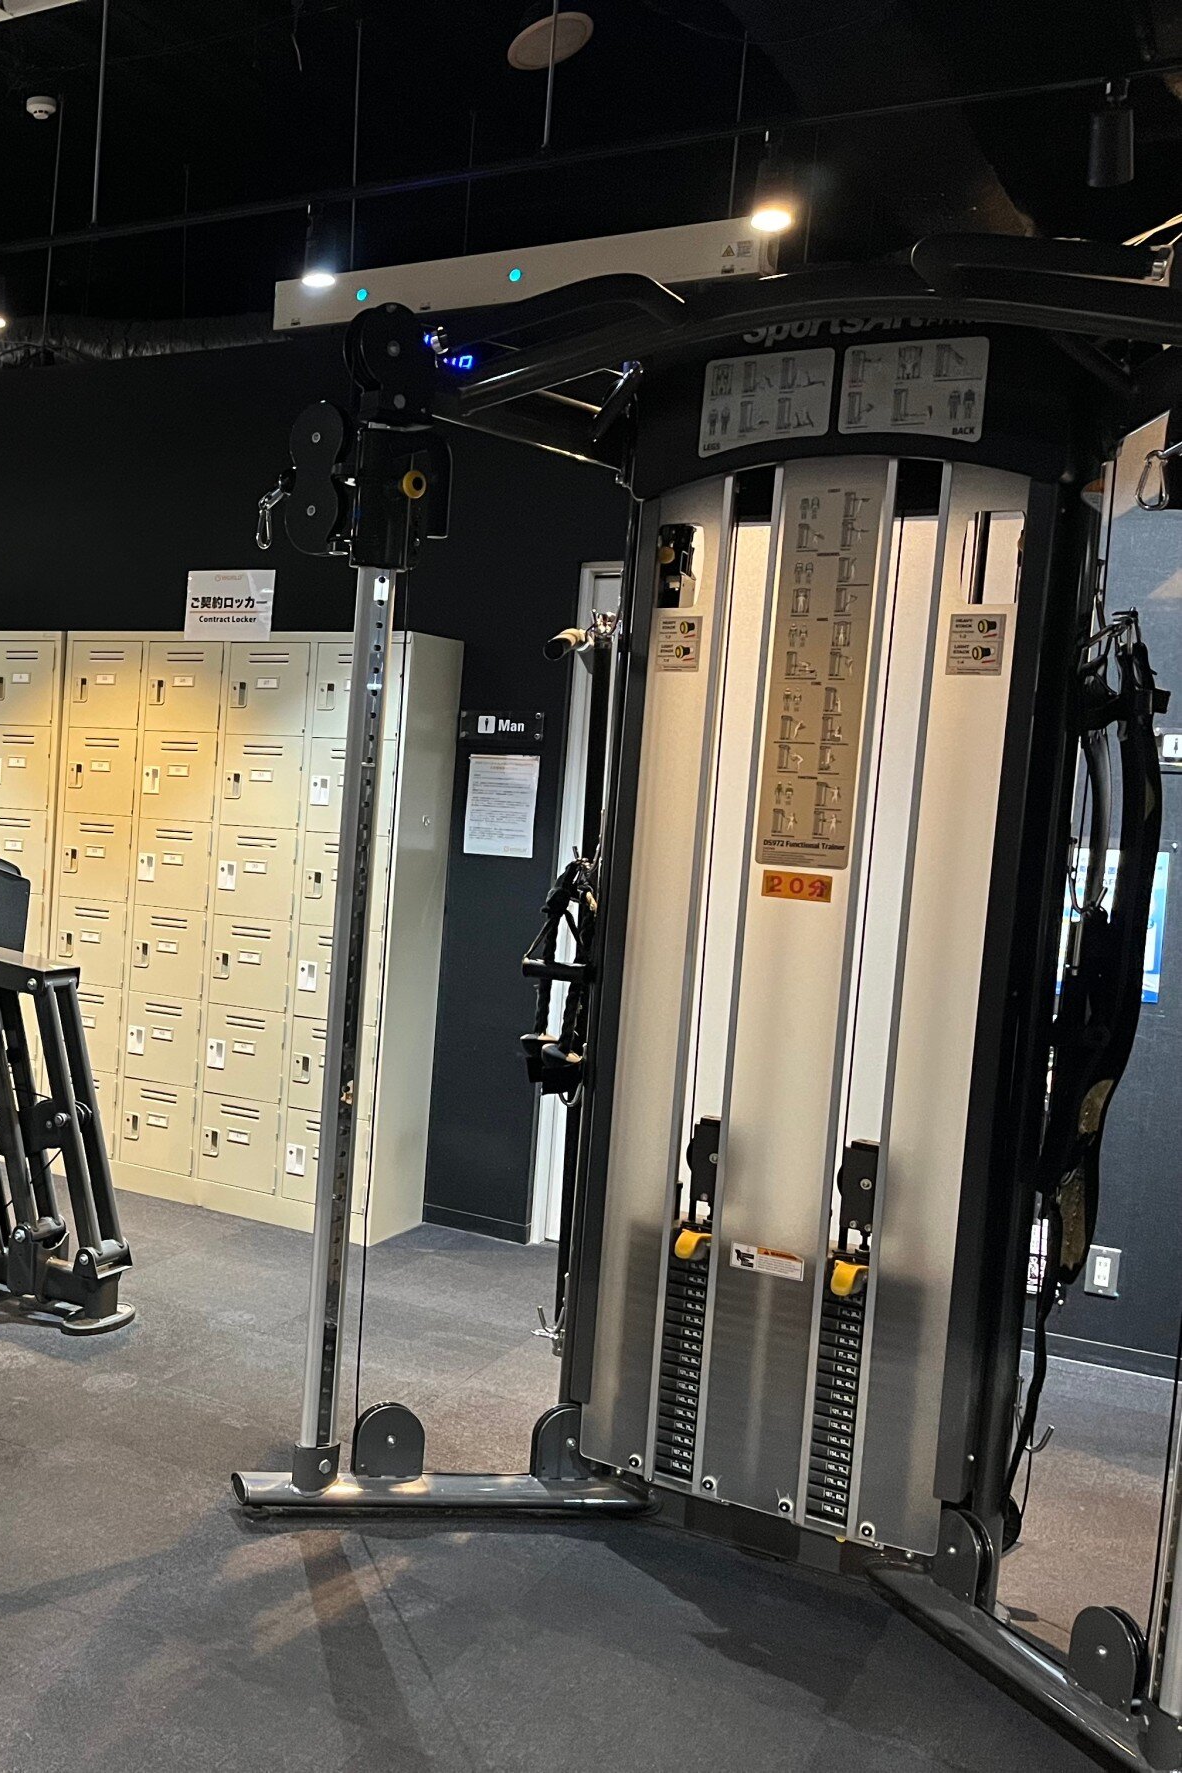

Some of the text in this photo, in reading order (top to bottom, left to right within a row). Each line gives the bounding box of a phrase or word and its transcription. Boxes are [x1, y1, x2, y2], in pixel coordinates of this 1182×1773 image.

[951, 426, 975, 436] BACK
[702, 442, 721, 451] LEGS
[191, 596, 268, 609] ご契約ロッカー
[199, 615, 257, 623] Contract Locker
[498, 719, 525, 732] Man
[763, 839, 846, 851] DS972 Functional Trainer
